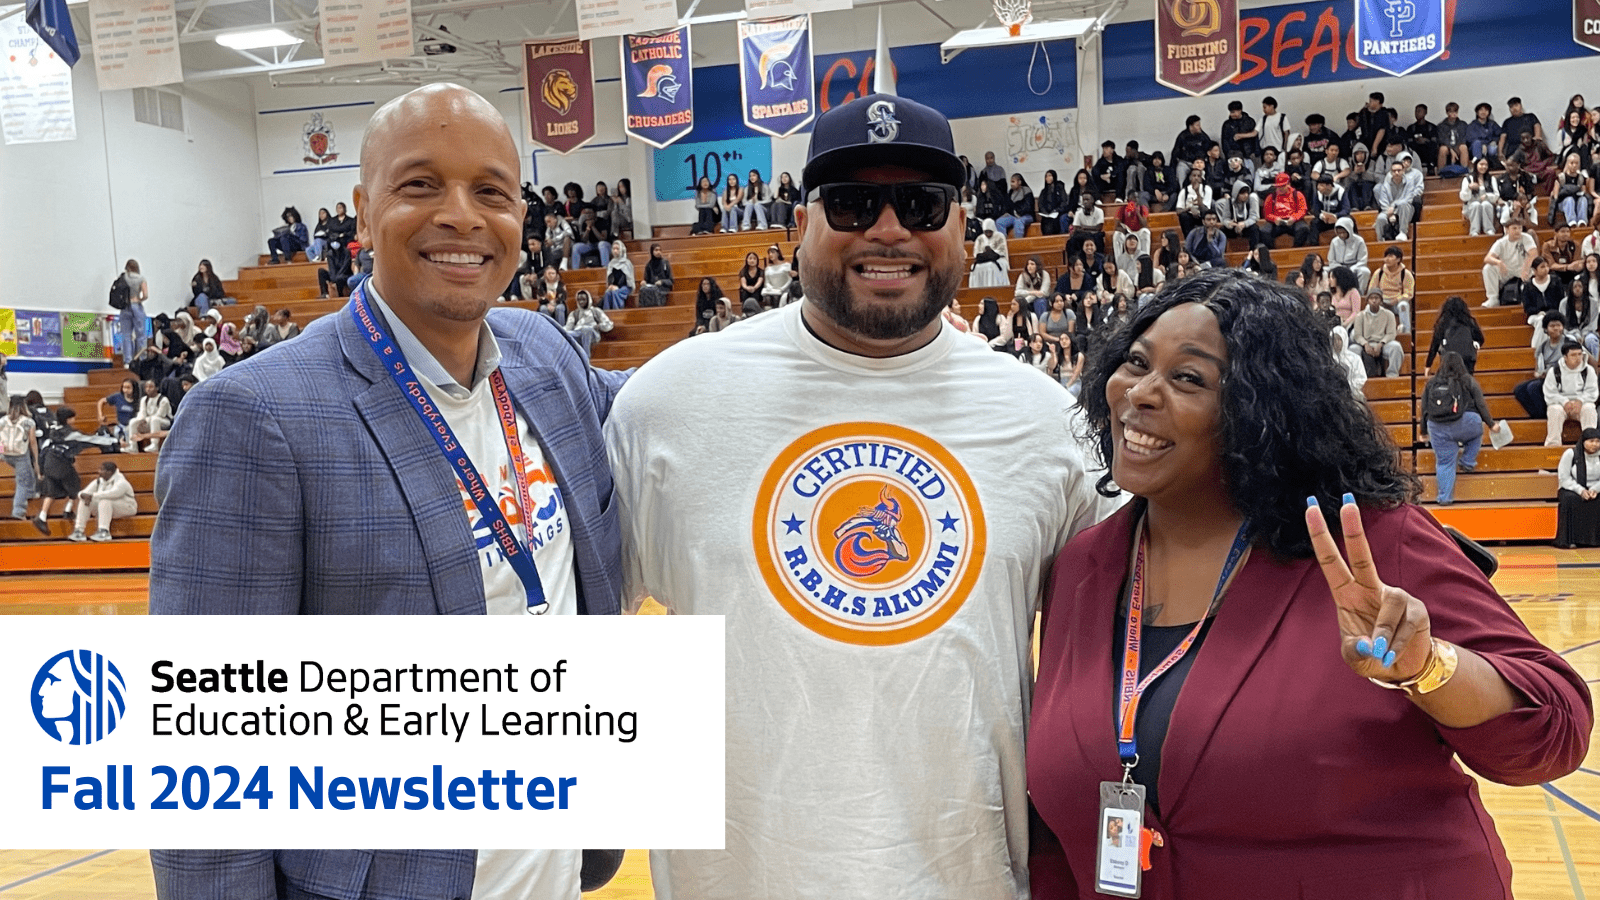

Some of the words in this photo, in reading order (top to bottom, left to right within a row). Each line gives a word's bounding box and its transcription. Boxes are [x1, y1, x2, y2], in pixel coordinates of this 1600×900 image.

[531, 41, 584, 60] LAKESIDE
[631, 45, 682, 63] CATHOLIC
[1167, 38, 1228, 60] FIGHTING
[1363, 33, 1436, 56] PANTHERS
[1180, 56, 1216, 75] IRISH
[627, 109, 691, 128] CRUSADERS
[751, 98, 809, 119] SPARTANS
[547, 120, 579, 137] LIONS
[383, 346, 393, 355] a
[393, 362, 406, 375] is
[405, 381, 456, 452] Everybody
[457, 457, 486, 501] Where
[792, 442, 946, 500] CERTIFIED
[492, 519, 518, 556] RBHS
[784, 545, 867, 616] R.B.H.S
[872, 541, 960, 617] ALUMNI
